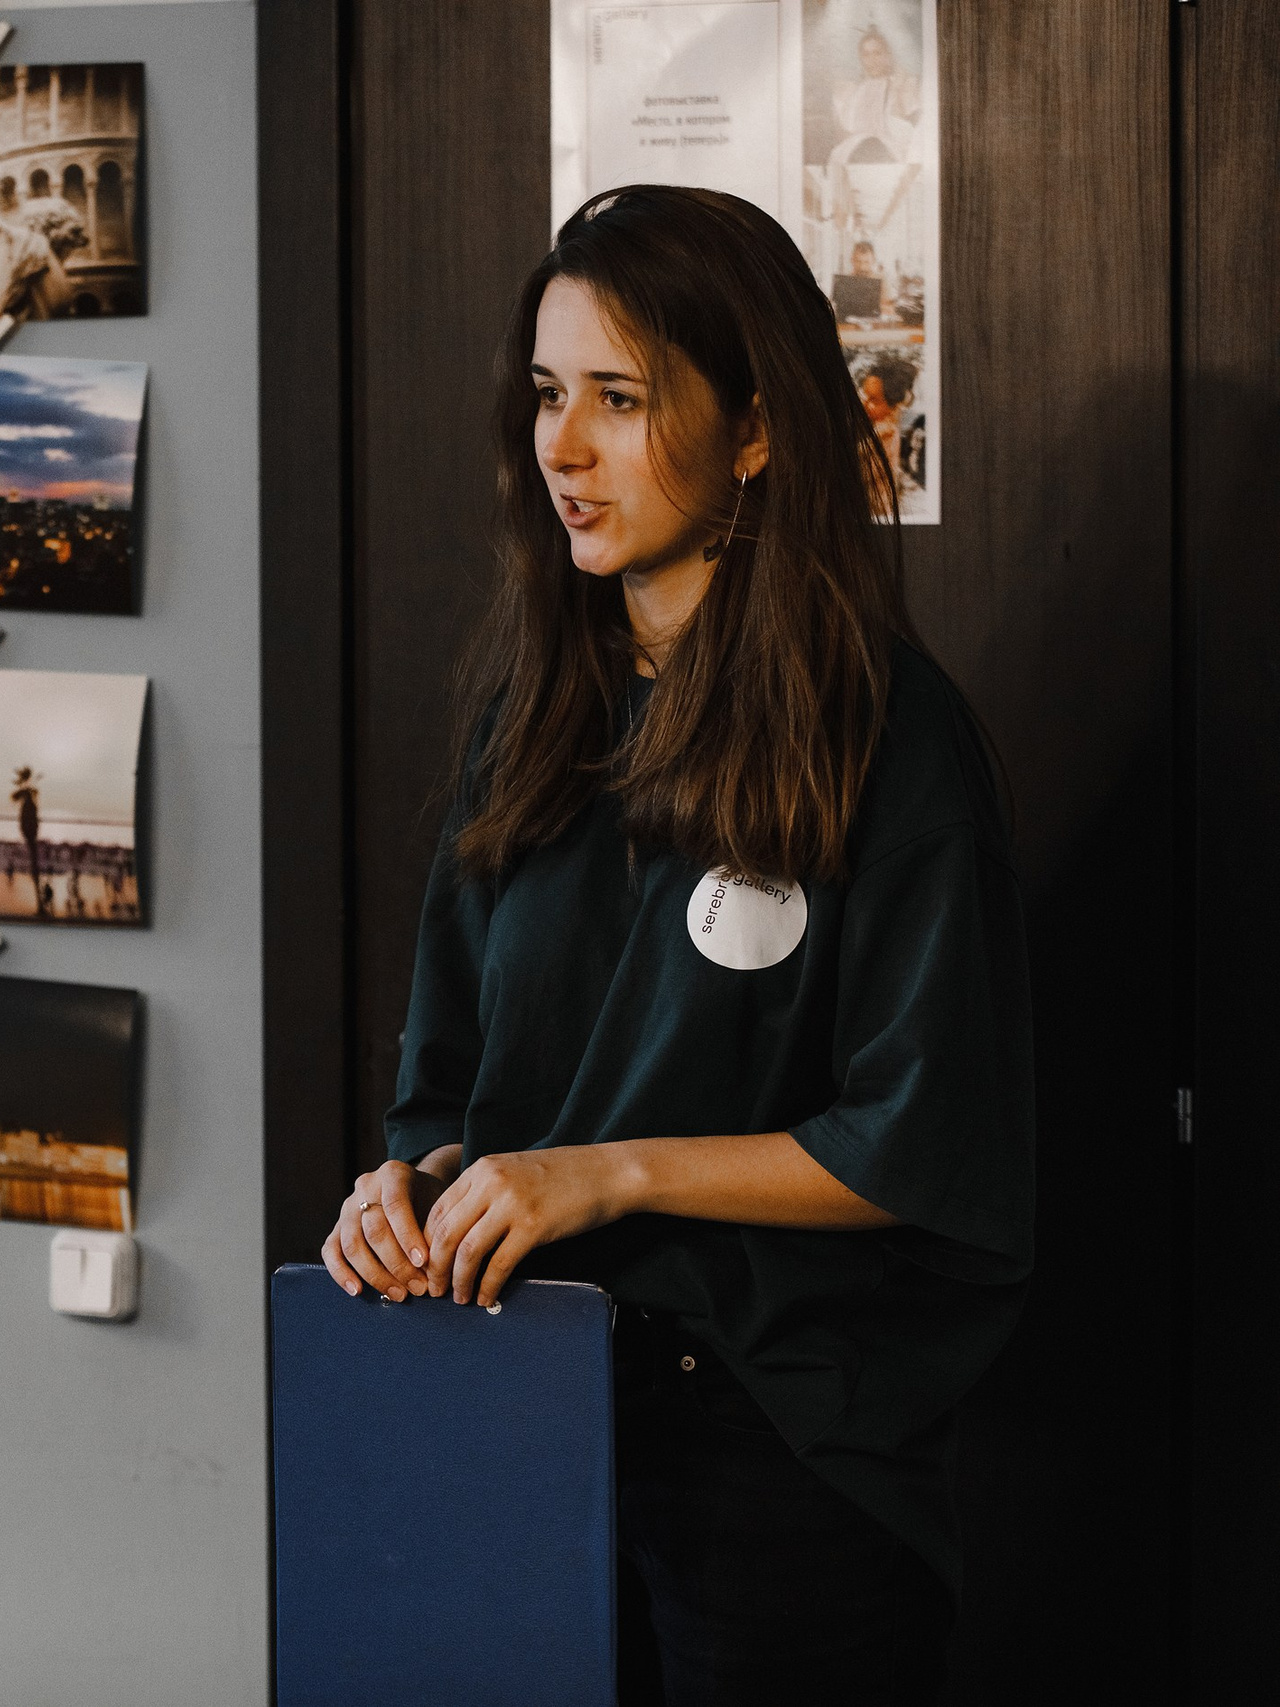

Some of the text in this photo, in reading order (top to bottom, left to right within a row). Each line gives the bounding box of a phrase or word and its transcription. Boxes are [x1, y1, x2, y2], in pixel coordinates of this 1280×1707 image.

[642, 95, 720, 108] фотовыставка
[685, 115, 731, 127] котором
[733, 872, 792, 905] gallery
